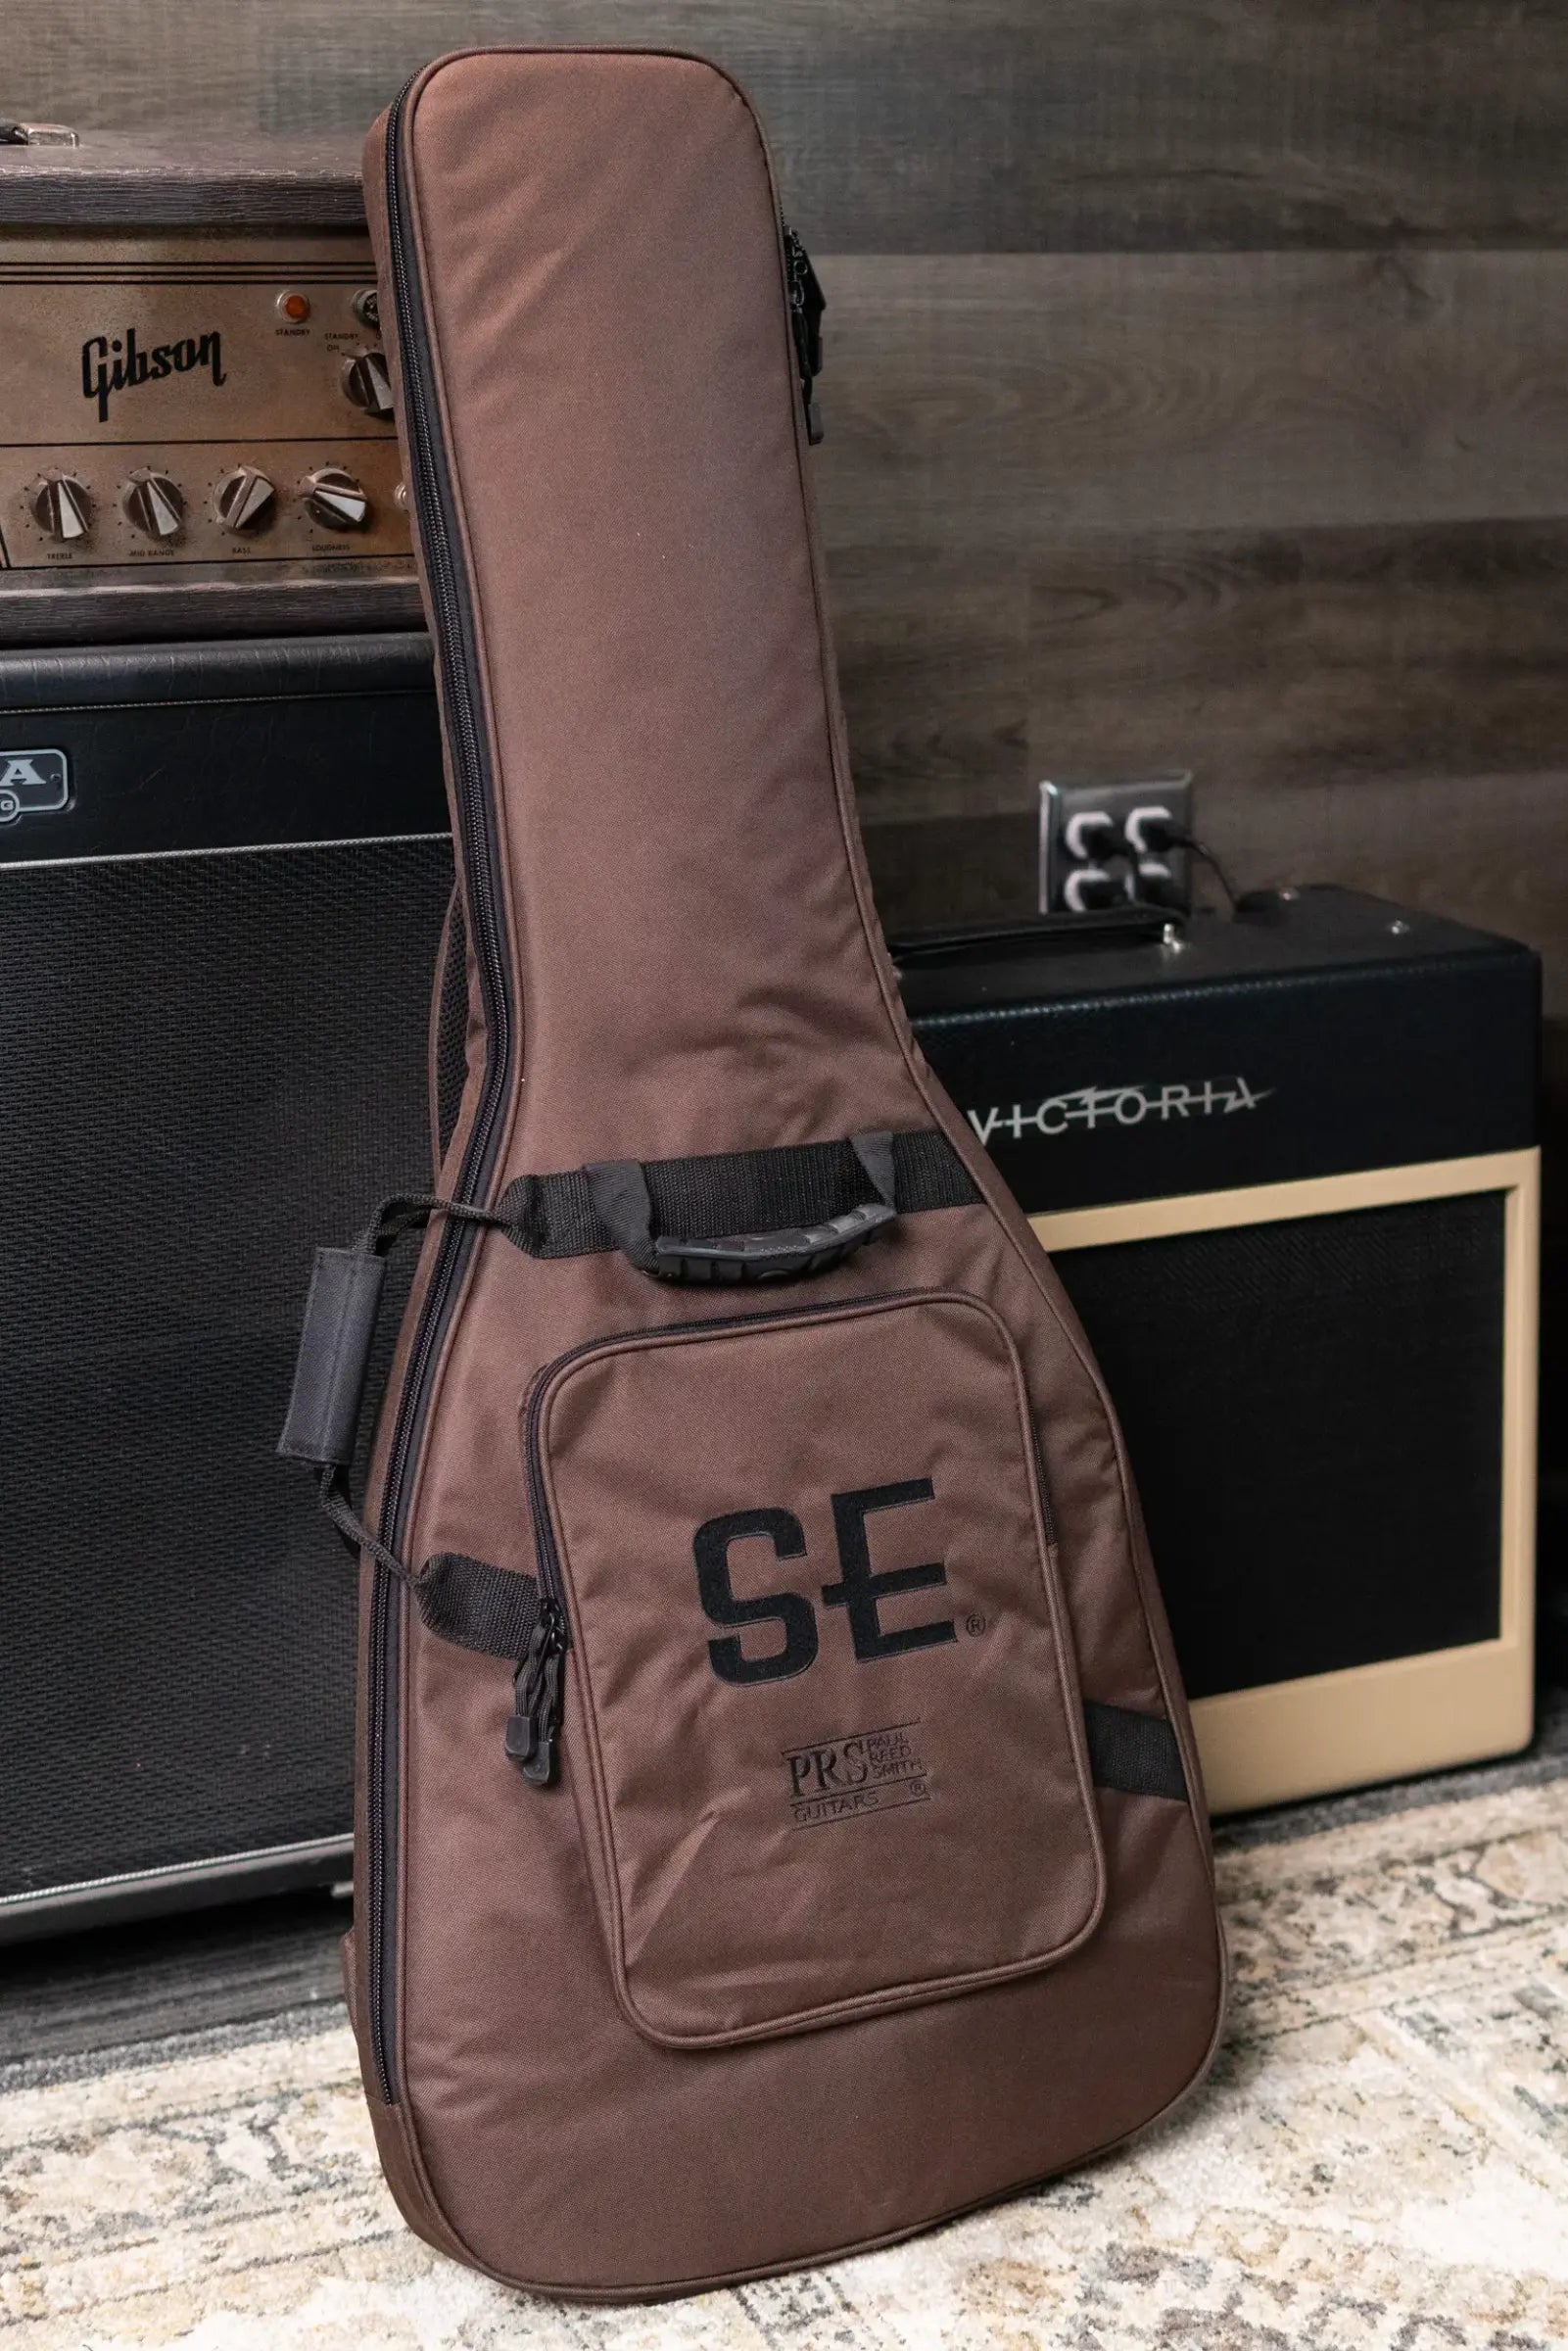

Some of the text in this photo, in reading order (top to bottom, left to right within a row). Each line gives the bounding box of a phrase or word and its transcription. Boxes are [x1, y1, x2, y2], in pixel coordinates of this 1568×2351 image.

[82, 327, 227, 423] Gibson
[967, 1076, 1273, 1147] VICTORIA
[693, 1476, 958, 1687] SE
[785, 1742, 870, 1799] PRS
[873, 1756, 924, 1780] SMITH
[794, 1792, 881, 1823] GUITARS
